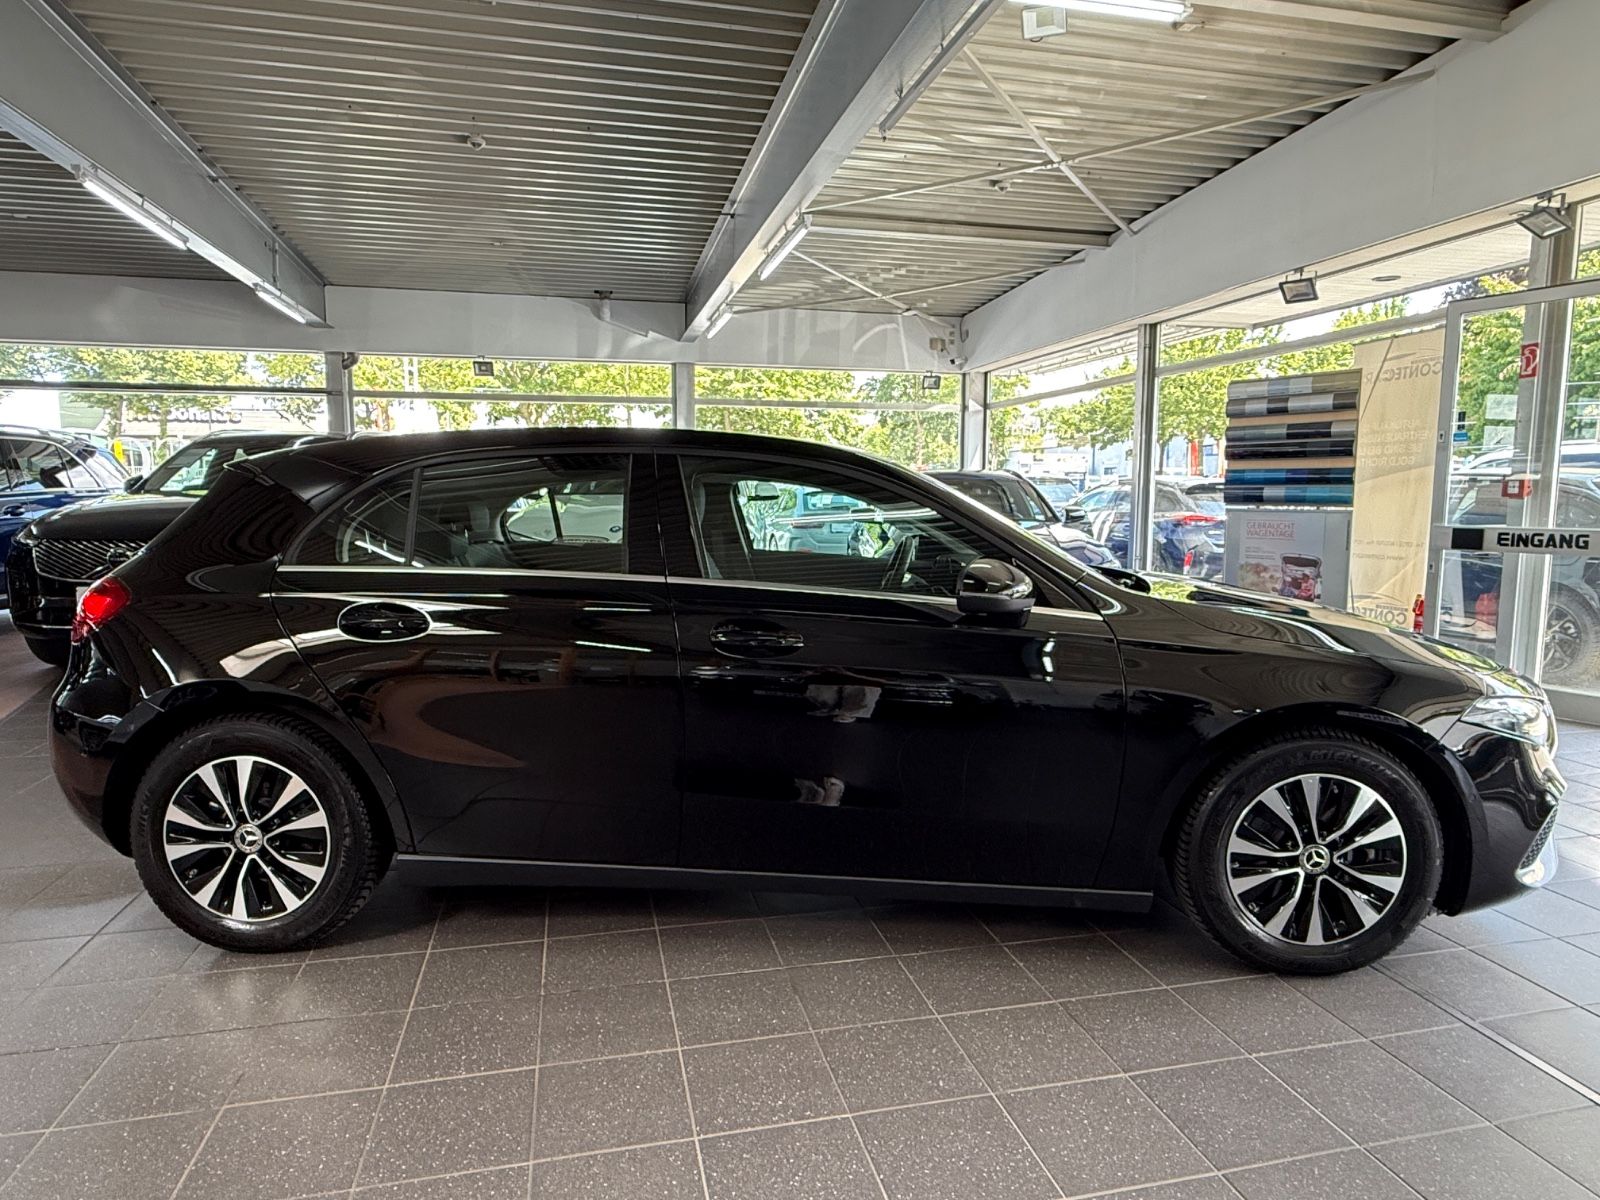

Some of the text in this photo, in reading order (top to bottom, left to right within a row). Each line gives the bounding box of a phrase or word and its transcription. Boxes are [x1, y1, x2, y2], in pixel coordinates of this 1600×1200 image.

[1247, 521, 1295, 529] GEBRAUCHT
[1247, 529, 1295, 537] WAGENTAGE
[1497, 532, 1590, 550] EINGANG
